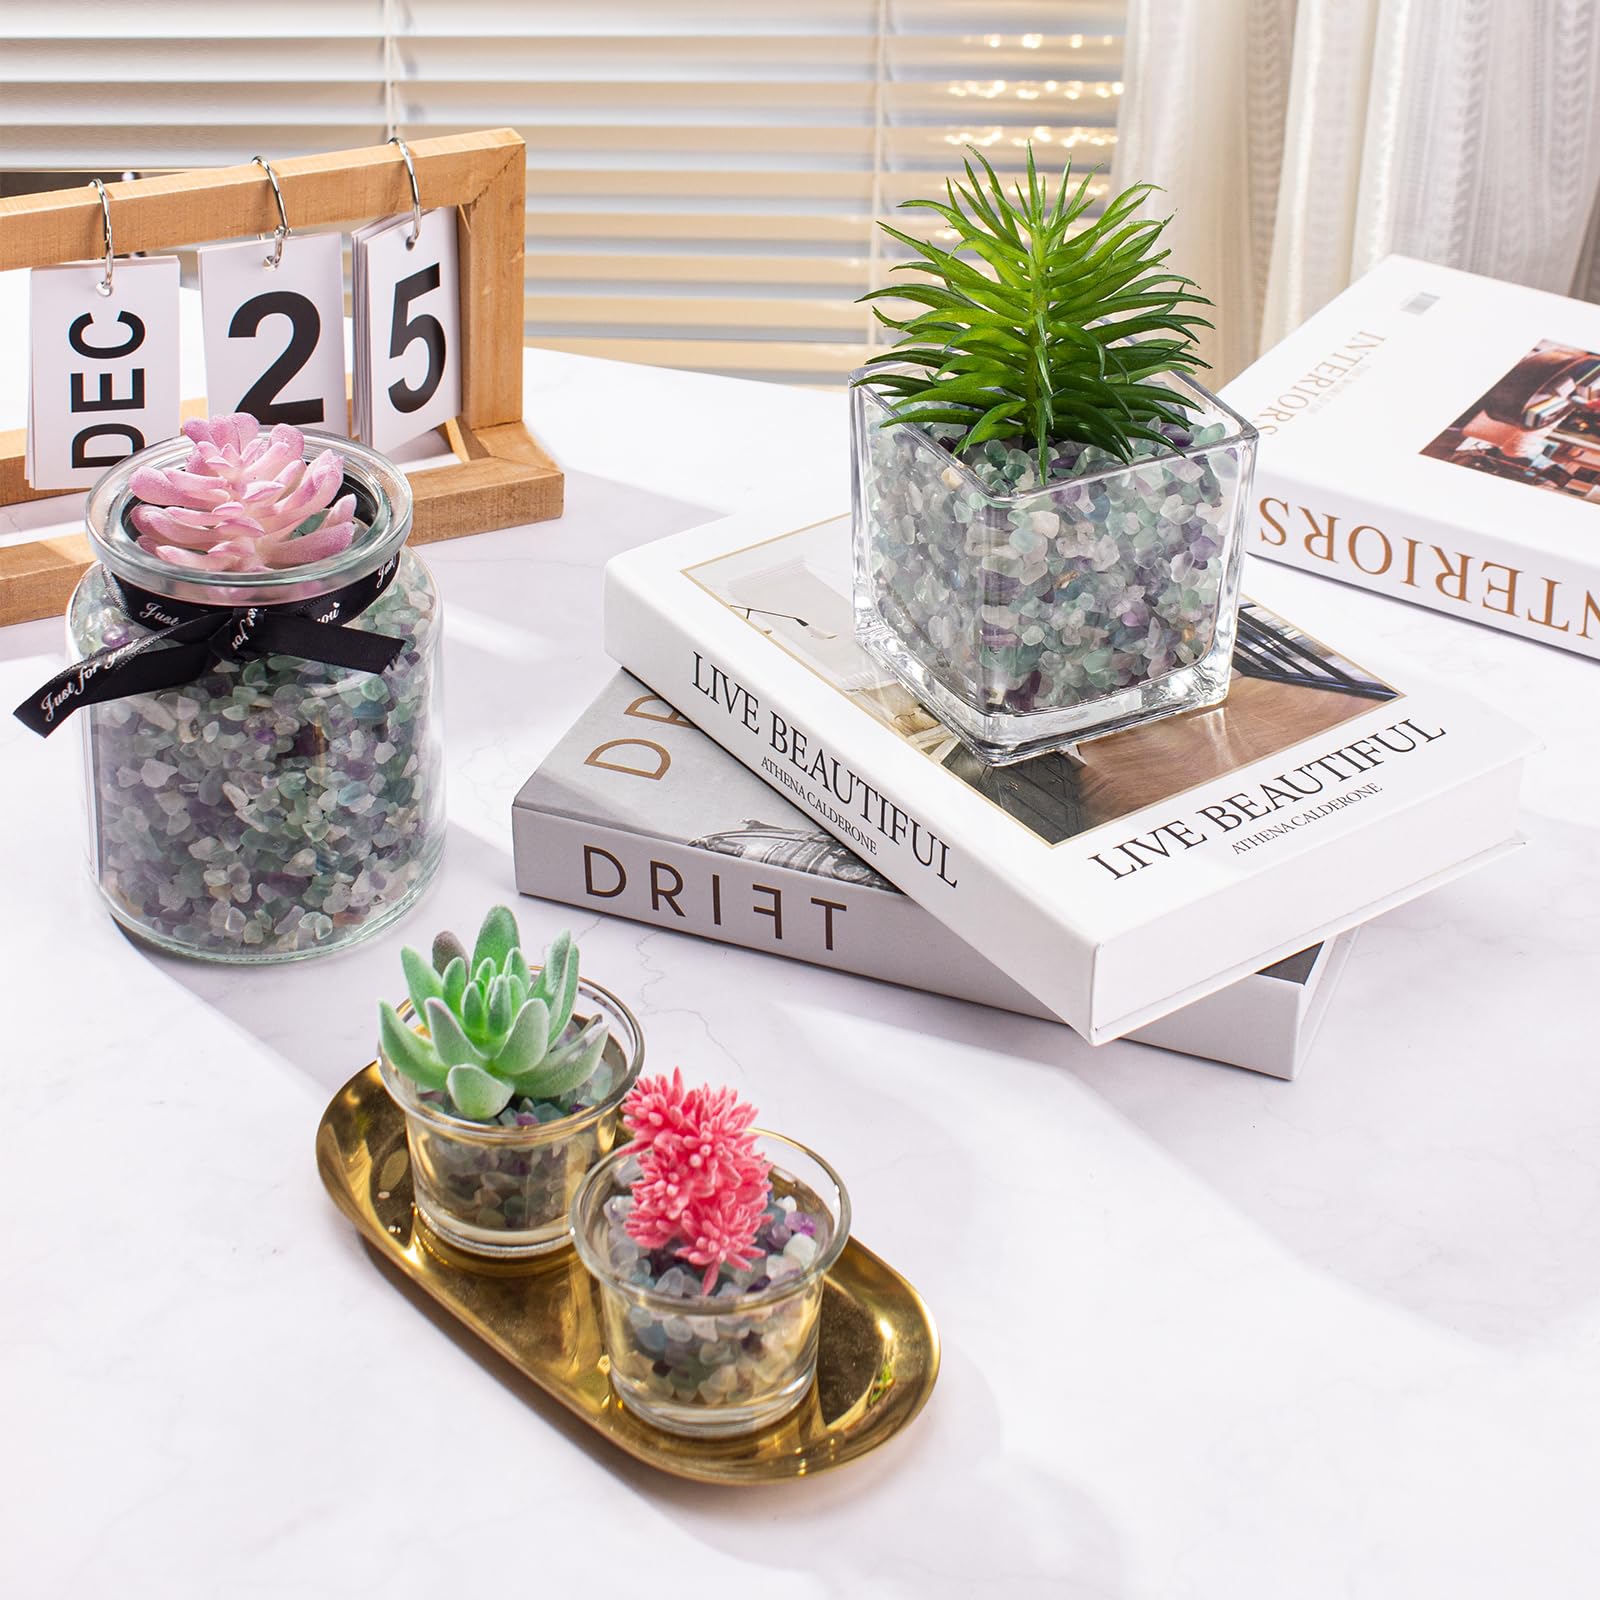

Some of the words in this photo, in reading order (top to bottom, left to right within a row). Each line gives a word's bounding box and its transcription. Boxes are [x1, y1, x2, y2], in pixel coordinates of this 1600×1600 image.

[68, 310, 146, 469] DEC
[228, 290, 325, 426] 2
[388, 262, 447, 414] 5
[40, 681, 76, 722] Just
[75, 661, 100, 696] for
[103, 638, 141, 670] you
[691, 651, 760, 735] LIVE
[768, 710, 958, 889] BEAUTIFUL
[760, 755, 807, 801] ATHENA
[806, 791, 878, 856] CALDERONE
[1087, 819, 1208, 881] LIVE
[1194, 718, 1447, 833] BEAUTIFUL
[1230, 821, 1294, 856] ATHENA
[1291, 781, 1384, 828] CALDERONE
[583, 844, 848, 951] DRIFT
